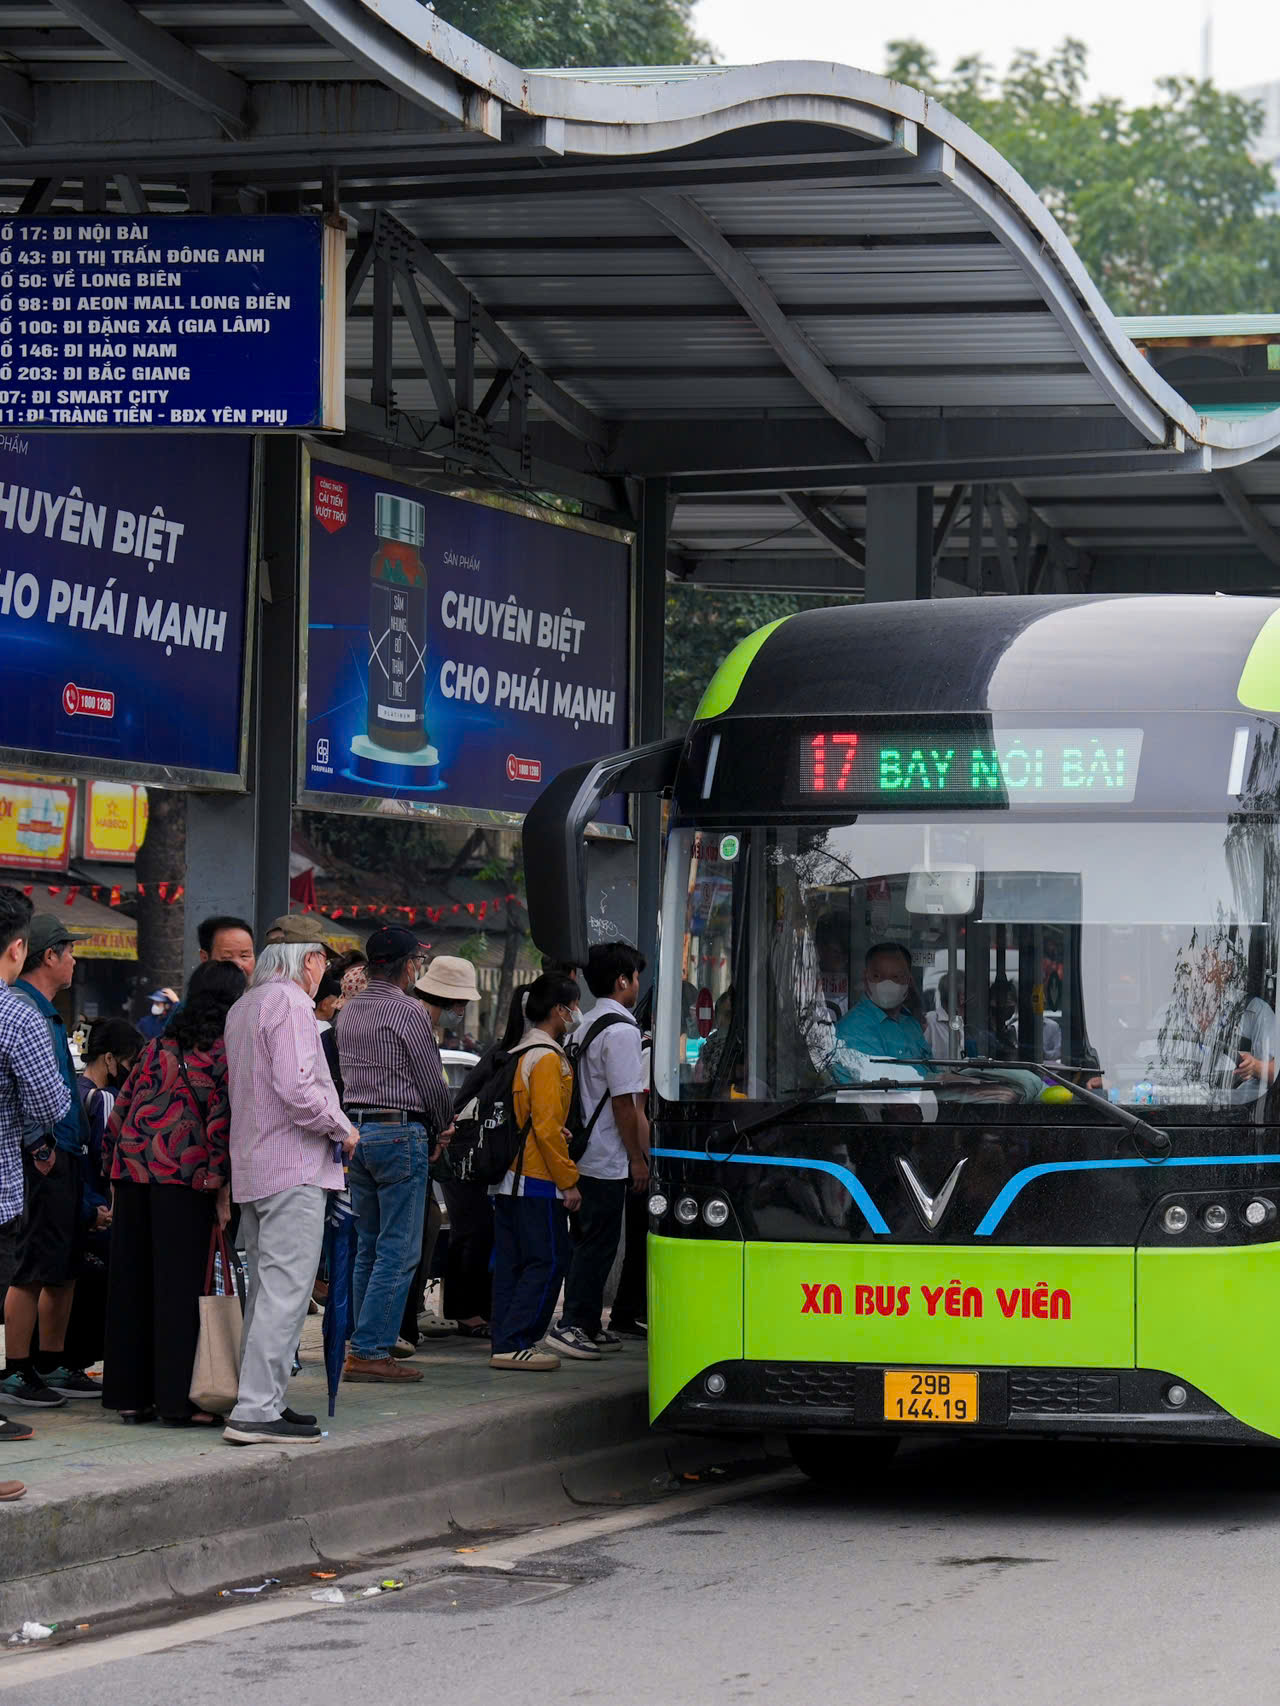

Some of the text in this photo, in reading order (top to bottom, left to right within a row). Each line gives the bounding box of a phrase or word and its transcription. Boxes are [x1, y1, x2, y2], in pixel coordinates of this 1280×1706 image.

[20, 226, 47, 240] 17:
[53, 226, 72, 240] ĐI
[78, 223, 111, 243] NỘI
[117, 222, 149, 240] BÀI
[17, 250, 46, 265] 43:
[51, 250, 71, 265] ĐI
[76, 250, 106, 267] THỊ
[111, 244, 161, 264] TRẤN
[166, 246, 220, 264] ĐÔNG
[225, 248, 265, 263] ANH
[18, 273, 47, 288] 50:
[52, 268, 76, 288] VỀ
[81, 273, 131, 288] LONG
[136, 269, 182, 288] BIÊN
[18, 297, 48, 312] 98:
[51, 296, 71, 311] ĐI
[76, 296, 128, 311] AEON
[133, 295, 185, 310] MALL
[190, 295, 240, 310] LONG
[245, 292, 291, 310] BIÊN
[18, 320, 58, 335] 100:
[63, 319, 82, 334] ĐI
[87, 316, 140, 337] ĐẶNG
[146, 316, 172, 334] XÁ
[178, 318, 217, 335] (GIA
[222, 315, 271, 334] LÂM)
[18, 343, 59, 358] 146:
[63, 343, 83, 358] ĐI
[88, 338, 127, 358] HÀO
[132, 343, 177, 358] NAM
[17, 366, 58, 381] 203:
[62, 366, 82, 381] ĐI
[88, 360, 126, 381] BẮC
[132, 366, 191, 381] GIANG
[31, 390, 51, 404] ĐI
[56, 389, 123, 405] SMART
[128, 389, 169, 404] CITY
[26, 408, 45, 422] ĐI
[49, 405, 108, 423] TRÀNG
[112, 402, 153, 423] TIỀN
[170, 408, 207, 423] BĐX
[211, 405, 247, 423] YÊN
[251, 408, 288, 427] PHỤ
[112, 505, 185, 573] BIỆT
[47, 577, 129, 636] PHÁI
[134, 595, 228, 657] MẠNH
[441, 590, 586, 663] CHUYÊN BIỆT
[81, 695, 96, 709] 1800
[440, 660, 616, 731] CHO PHÁI MẠNH
[812, 734, 858, 791] 17
[879, 749, 955, 789] BAY
[801, 1279, 1071, 1320] XN BUS YÊN VIÊN
[910, 1375, 951, 1396] 29B
[896, 1398, 968, 1420] 144.19
